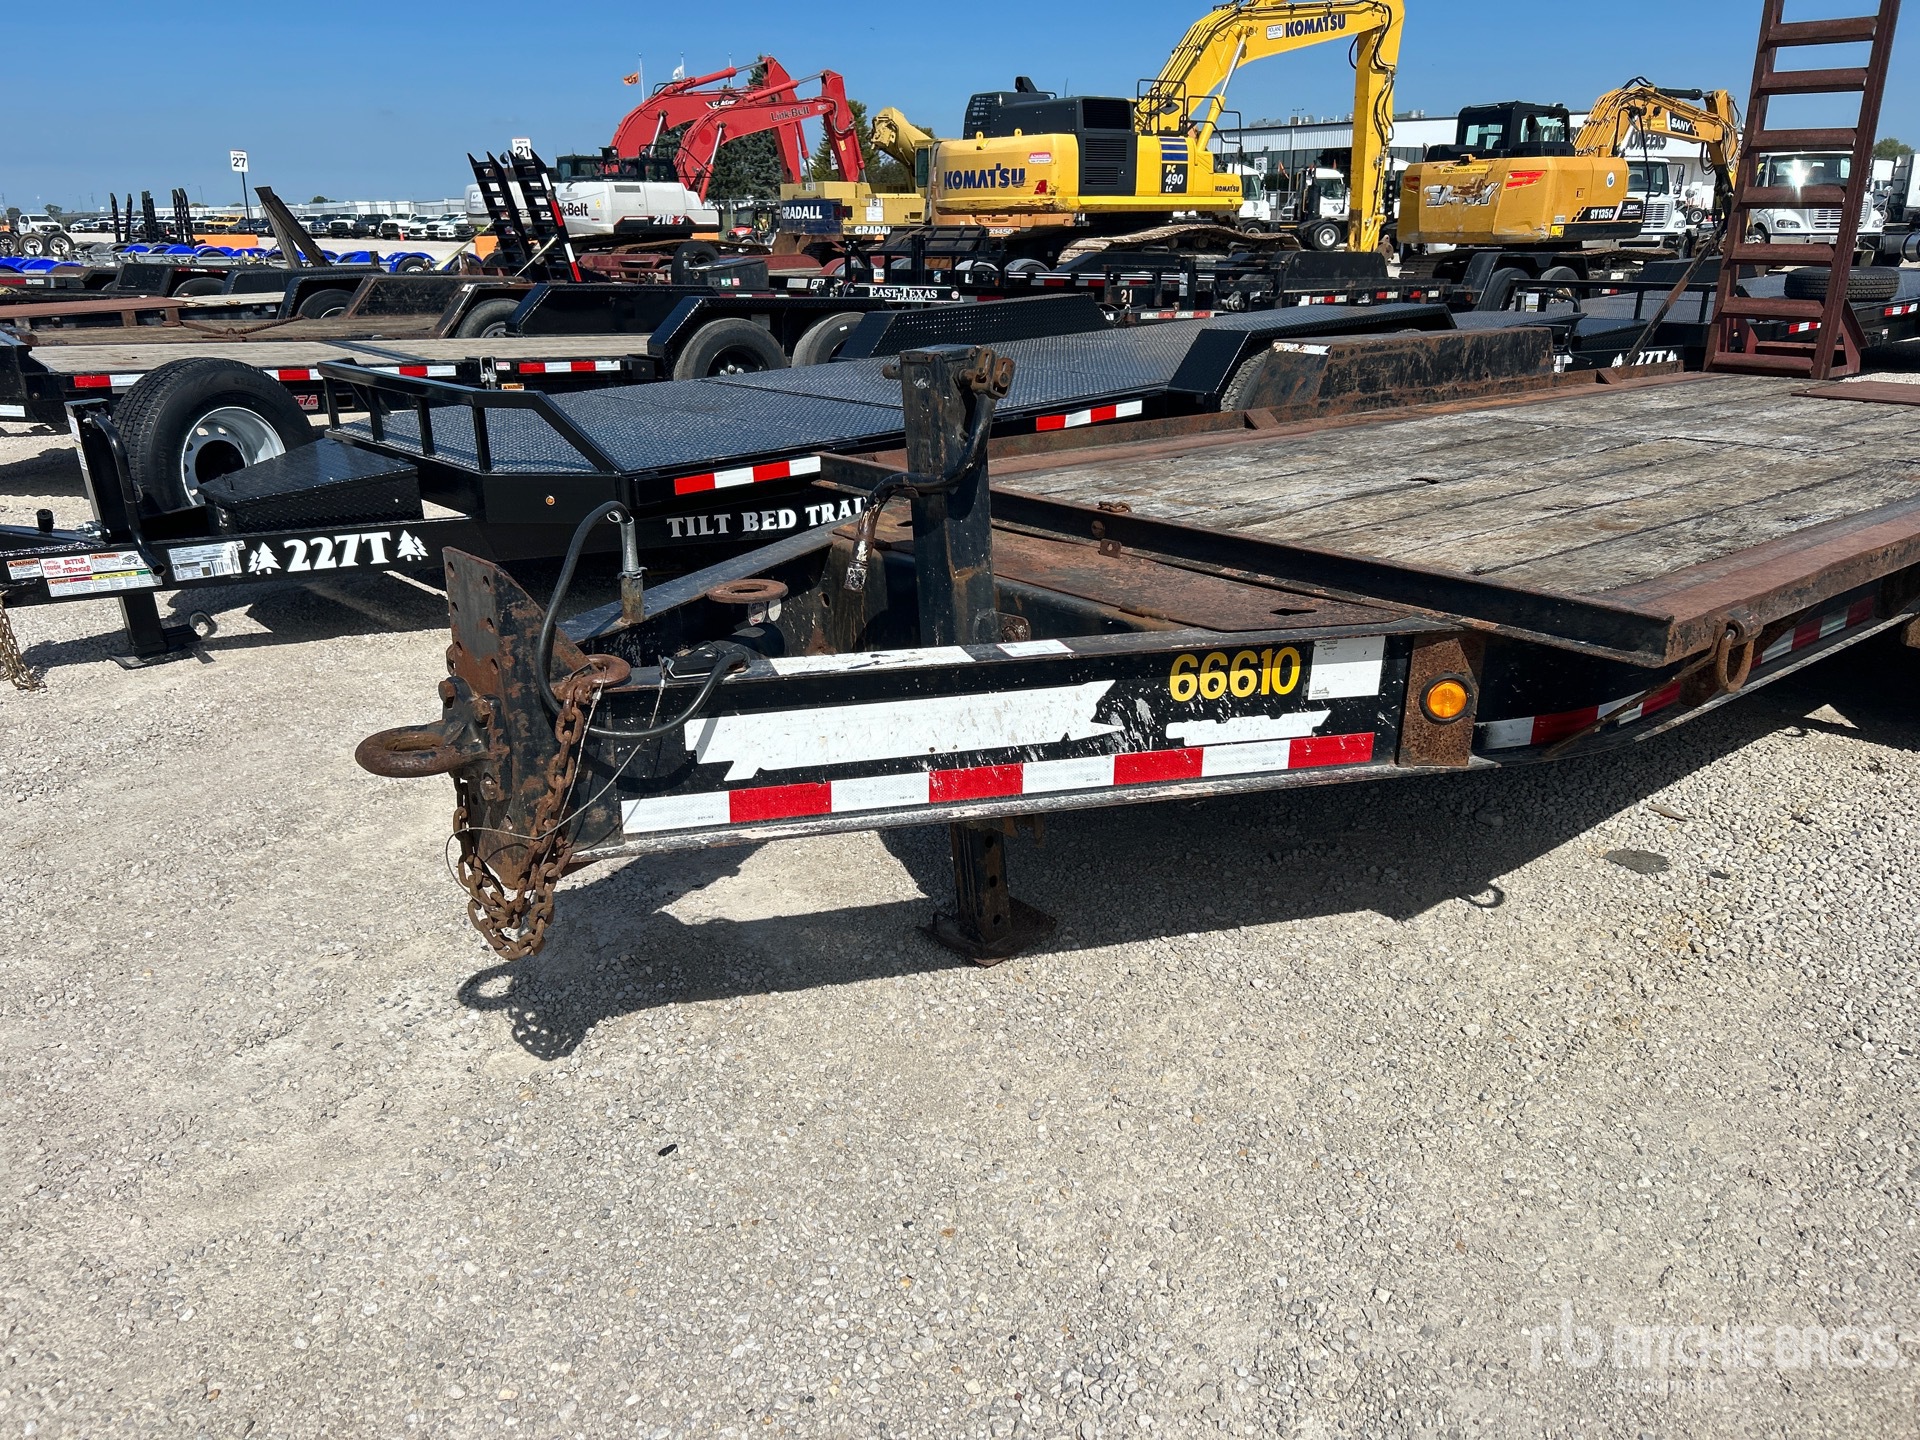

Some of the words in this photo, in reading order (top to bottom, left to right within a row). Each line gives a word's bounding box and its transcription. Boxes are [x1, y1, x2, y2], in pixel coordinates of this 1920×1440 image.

[1285, 14, 1346, 38] KOMATSU
[1671, 117, 1691, 132] SANY
[516, 146, 530, 157] 21
[232, 157, 246, 168] 27
[1165, 165, 1176, 173] PC
[944, 163, 1026, 190] KOMATSU
[1165, 174, 1184, 185] 490
[559, 202, 589, 217] k-Belt
[782, 206, 822, 219] GRADALL
[868, 286, 898, 298] EAST
[900, 287, 938, 299] TEXAS
[1120, 289, 1133, 303] 21
[666, 514, 731, 538] TILT
[742, 509, 797, 533] BED
[805, 496, 869, 527] TRAI
[283, 531, 391, 573] 227T
[1169, 646, 1302, 702] 66610
